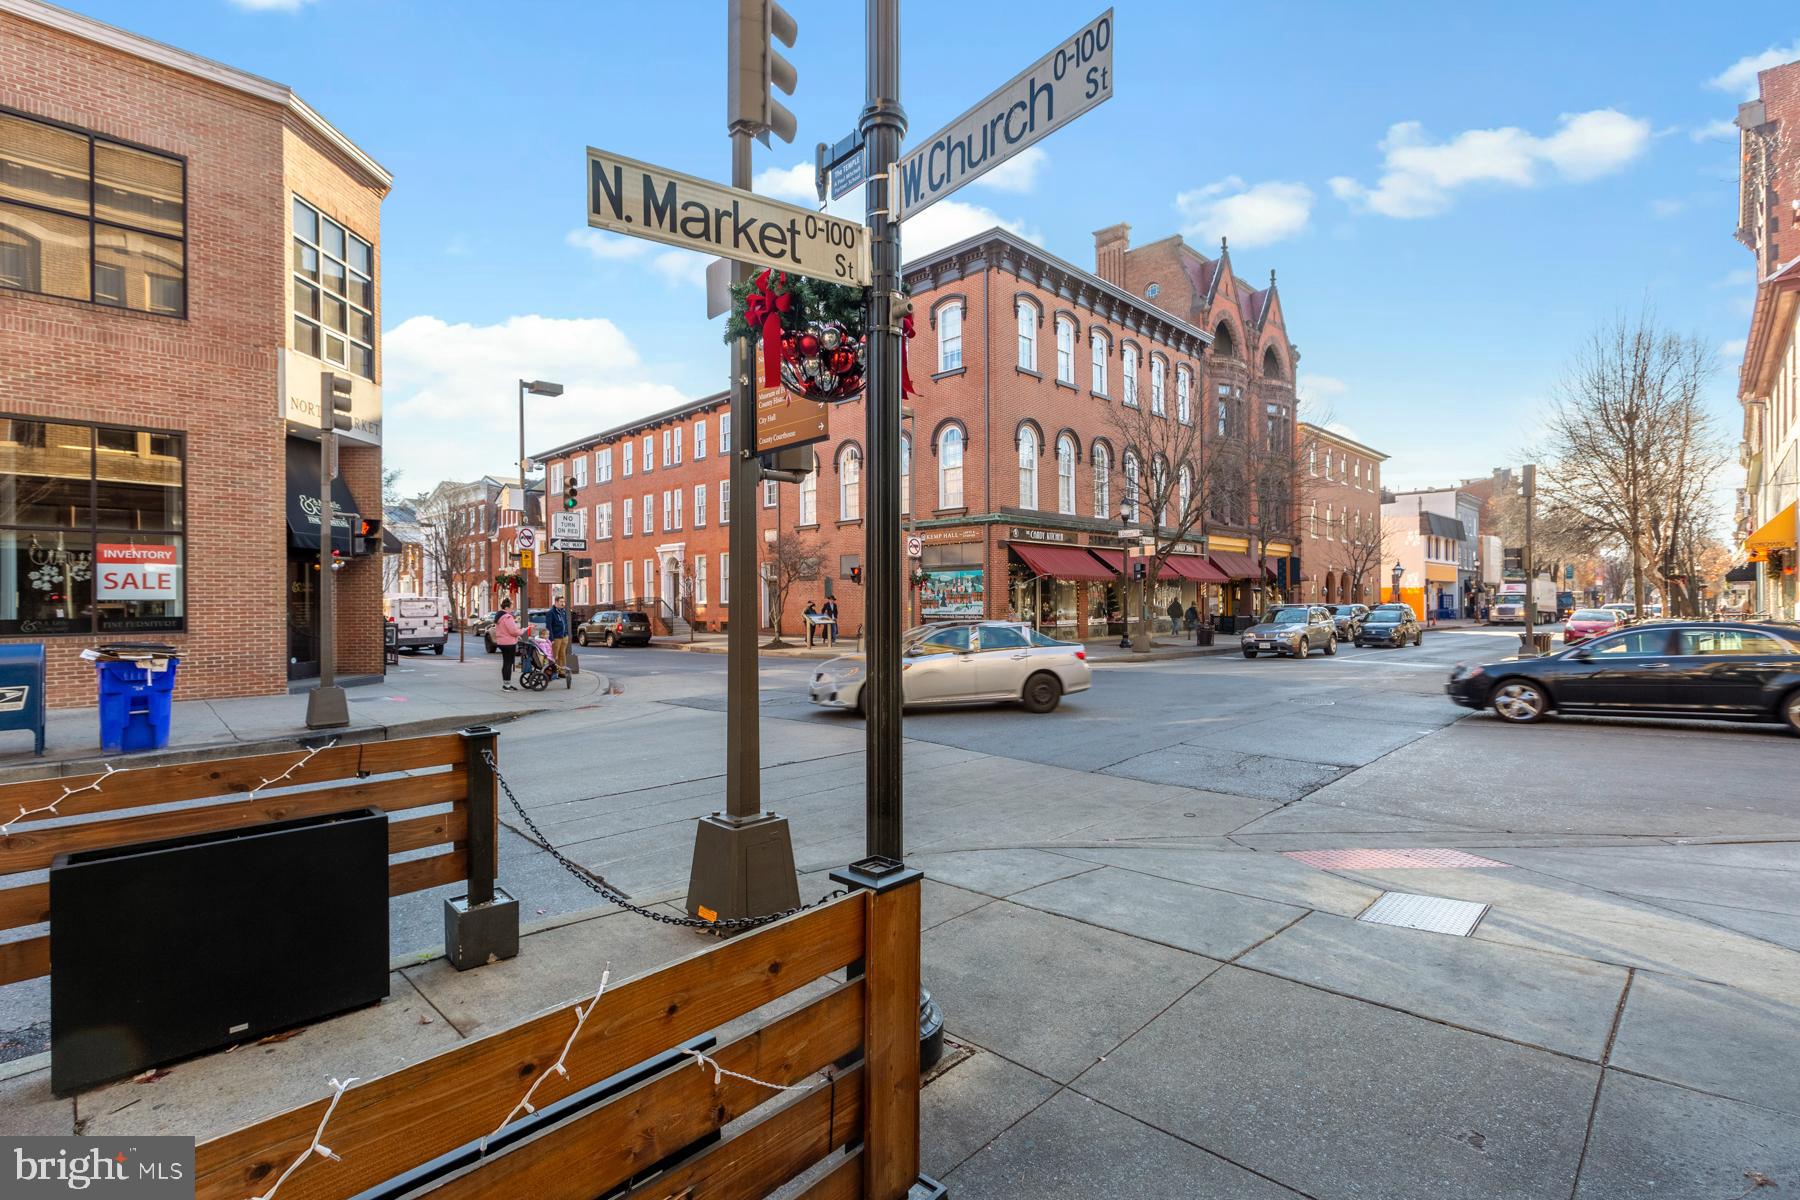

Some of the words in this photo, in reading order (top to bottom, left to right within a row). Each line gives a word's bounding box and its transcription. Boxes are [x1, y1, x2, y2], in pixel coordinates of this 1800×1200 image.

[1053, 18, 1111, 81] 0-100
[1085, 66, 1108, 99] St
[902, 152, 925, 208] W.
[928, 77, 1054, 193] Church
[834, 169, 843, 178] The
[843, 156, 860, 172] TEMPLE
[591, 159, 633, 223] N.
[642, 173, 801, 264] Market
[804, 214, 855, 249] 0-100
[835, 253, 854, 280] St
[290, 396, 321, 417] NORT
[353, 416, 380, 436] RKET
[759, 417, 767, 426] City
[767, 413, 776, 422] Hall
[759, 436, 773, 445] County
[773, 431, 797, 441] Courthouse
[103, 549, 172, 560] INVENTORY
[103, 572, 172, 590] SALE
[103, 621, 123, 629] FINE
